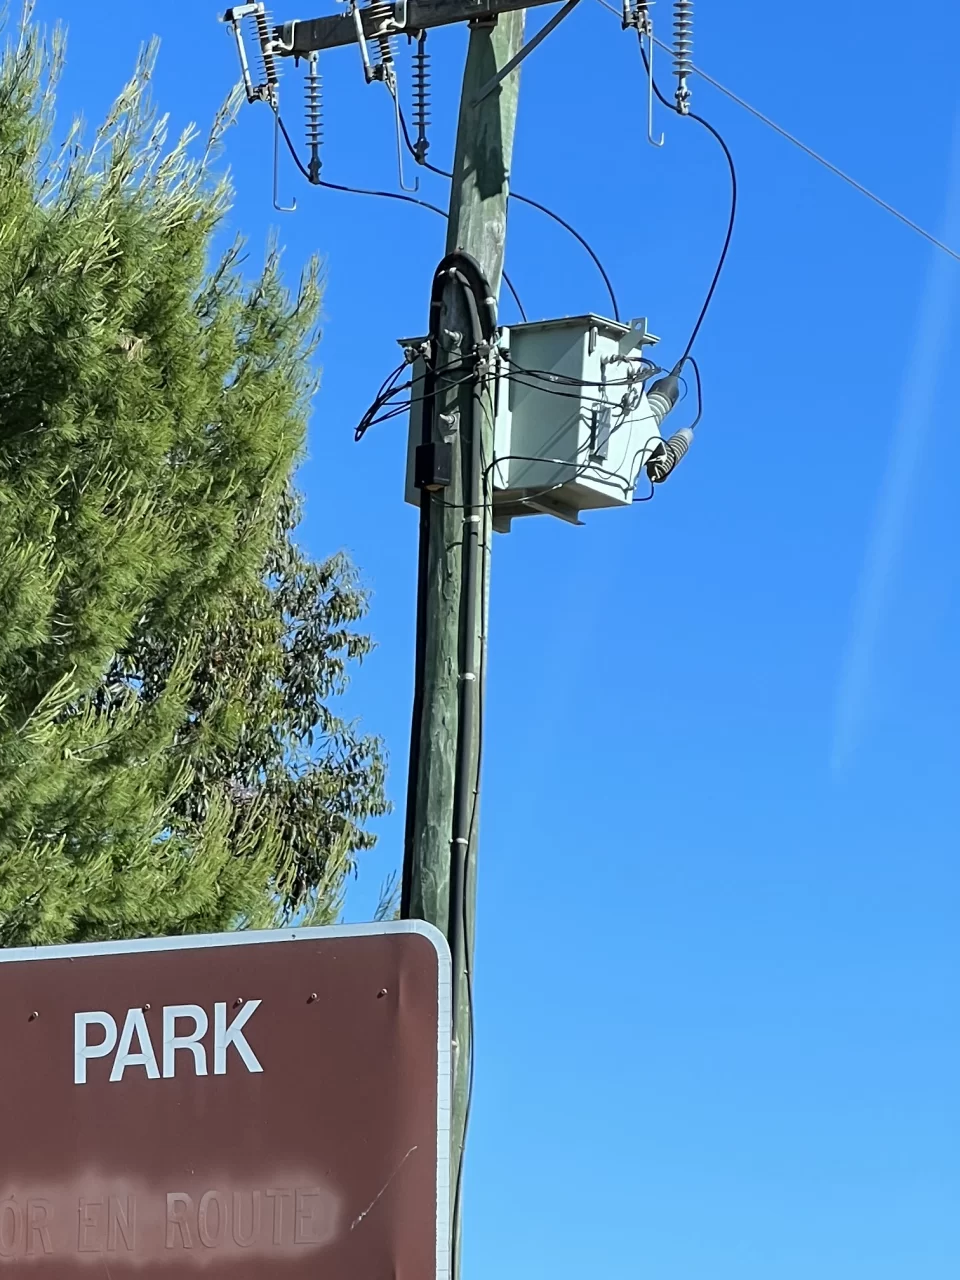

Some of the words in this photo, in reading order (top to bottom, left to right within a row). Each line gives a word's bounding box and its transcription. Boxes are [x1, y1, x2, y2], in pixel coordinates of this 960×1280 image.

[73, 999, 265, 1085] PARK
[77, 1195, 138, 1253] EN
[164, 1187, 322, 1250] ROUTE
